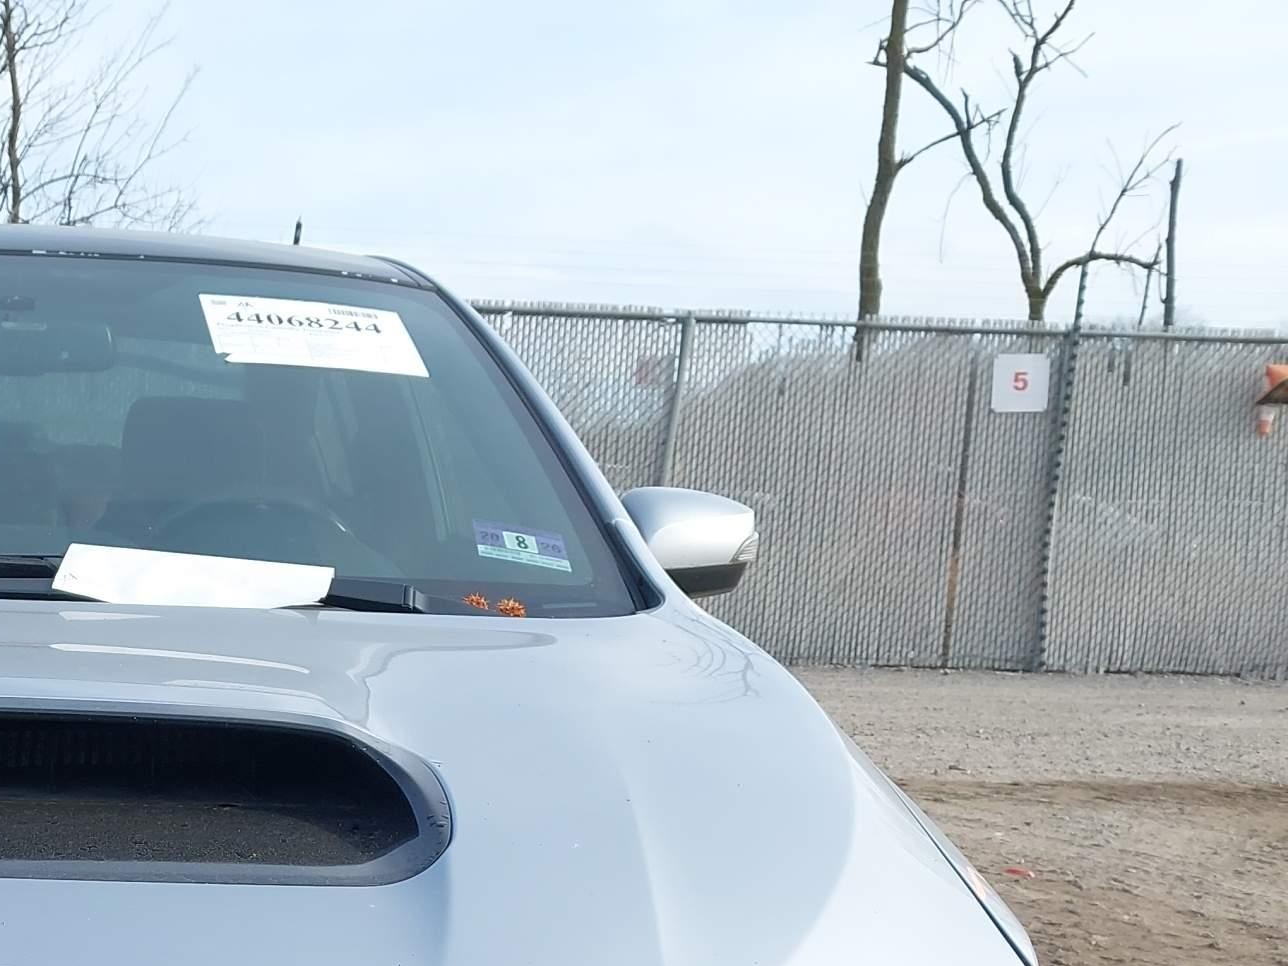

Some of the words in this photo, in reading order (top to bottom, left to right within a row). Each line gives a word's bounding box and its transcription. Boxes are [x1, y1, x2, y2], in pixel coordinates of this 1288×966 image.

[226, 311, 382, 334] 44068244
[1012, 371, 1029, 391] 5
[515, 535, 529, 550] 8
